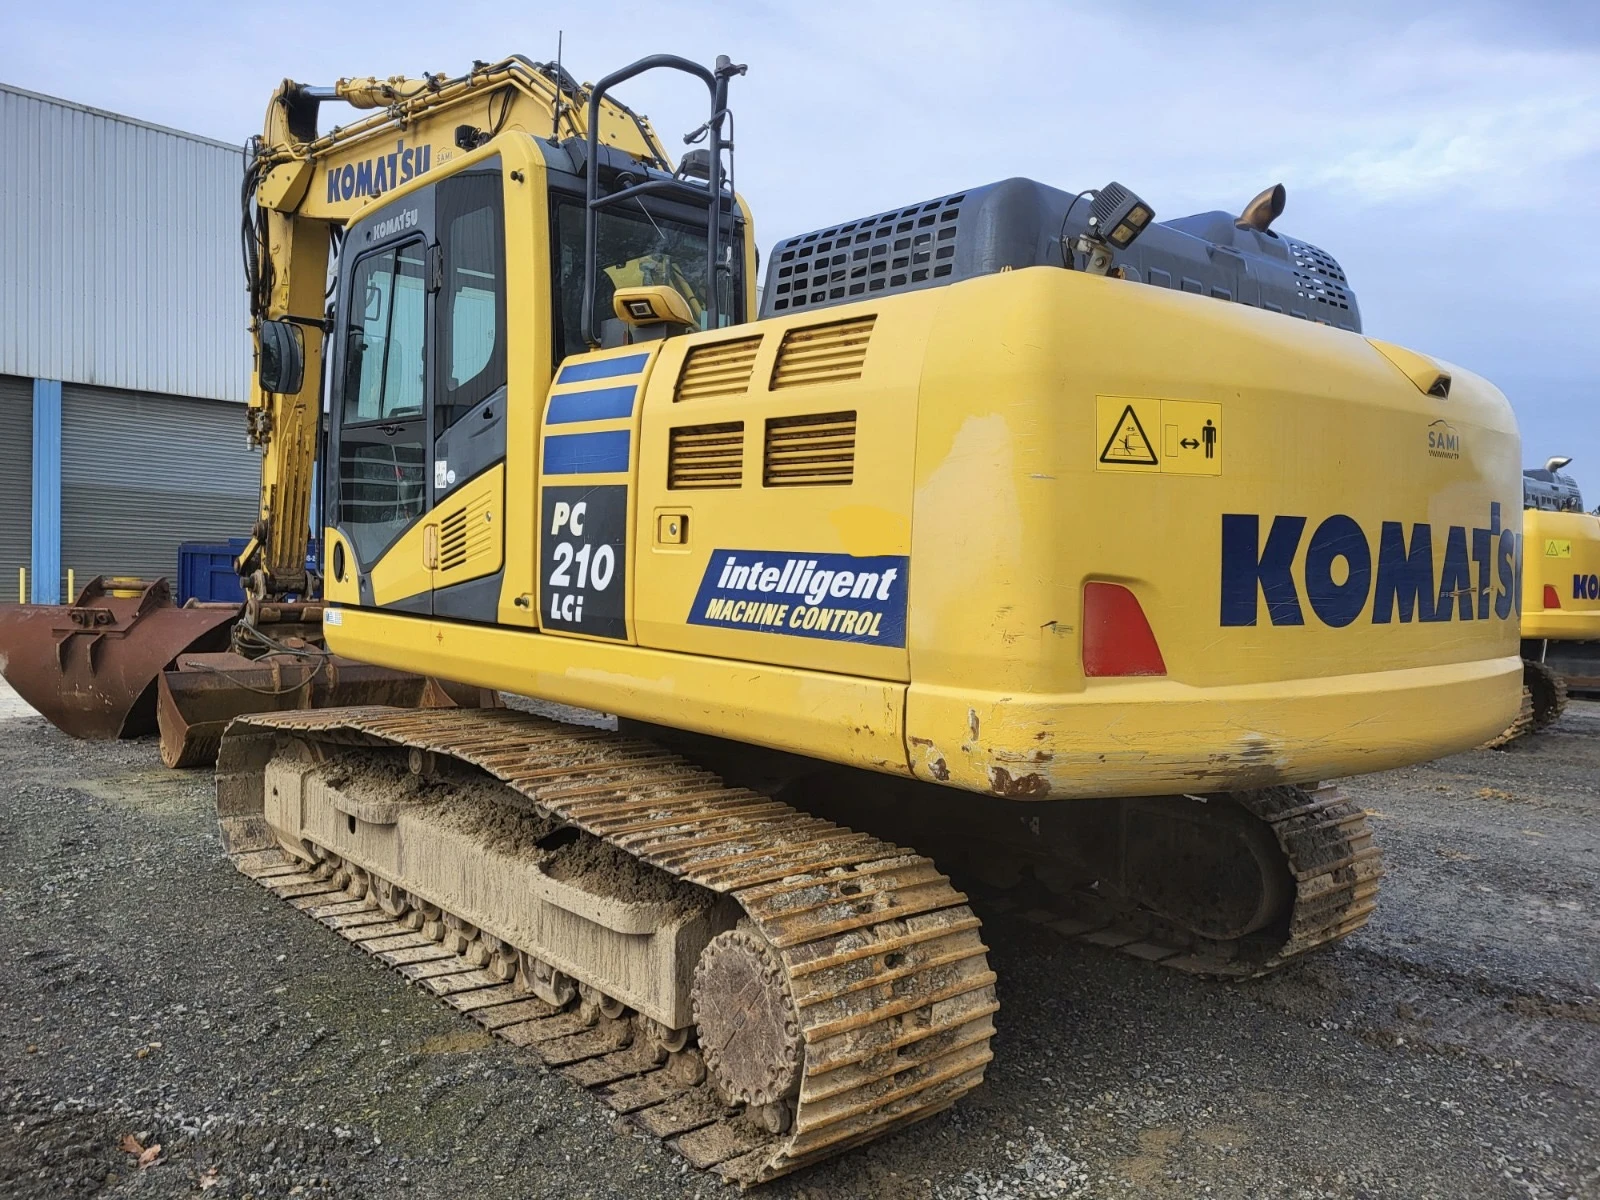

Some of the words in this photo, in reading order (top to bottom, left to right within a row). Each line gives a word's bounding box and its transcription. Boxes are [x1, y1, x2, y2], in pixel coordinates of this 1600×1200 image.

[327, 139, 431, 203] KOMATSU
[373, 209, 418, 240] KOMATSU
[1428, 431, 1459, 451] SAMI
[551, 502, 587, 536] PC
[549, 542, 615, 591] 210
[717, 556, 897, 605] intelligent
[1573, 574, 1600, 600] KO
[551, 593, 584, 622] LCi
[705, 598, 789, 627] MACHINE
[789, 606, 883, 636] CONTROL
